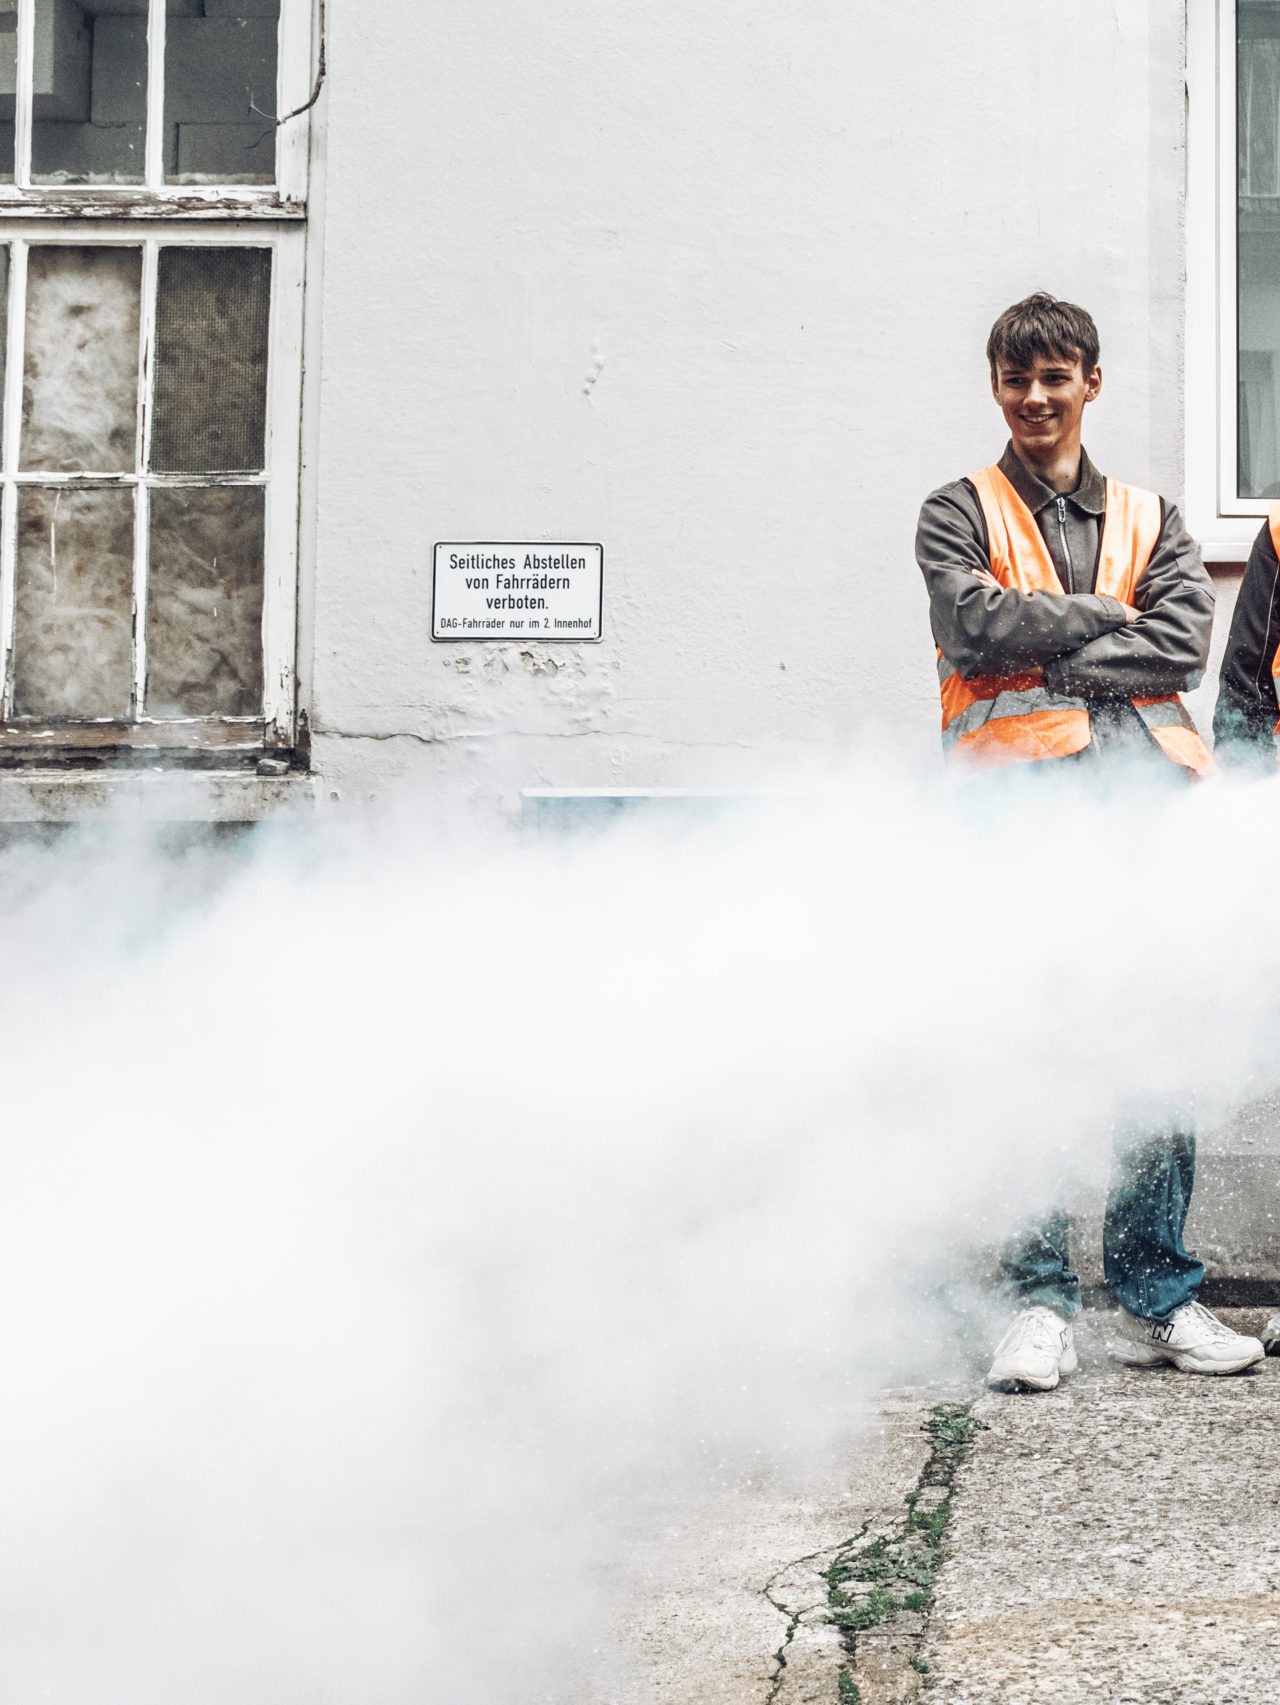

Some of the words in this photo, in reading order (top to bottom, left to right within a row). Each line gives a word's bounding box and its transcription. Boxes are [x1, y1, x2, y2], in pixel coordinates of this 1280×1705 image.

[449, 553, 516, 570] Seitliches
[523, 553, 586, 570] Abstellen
[465, 578, 489, 590] von
[496, 573, 570, 590] Fahrrädern
[486, 594, 549, 610] verboten.
[440, 617, 505, 629] DAG-Fahrräder
[509, 620, 524, 629] nur
[529, 618, 540, 629] im
[554, 618, 593, 629] Innenhof
[1151, 1322, 1175, 1343] N
